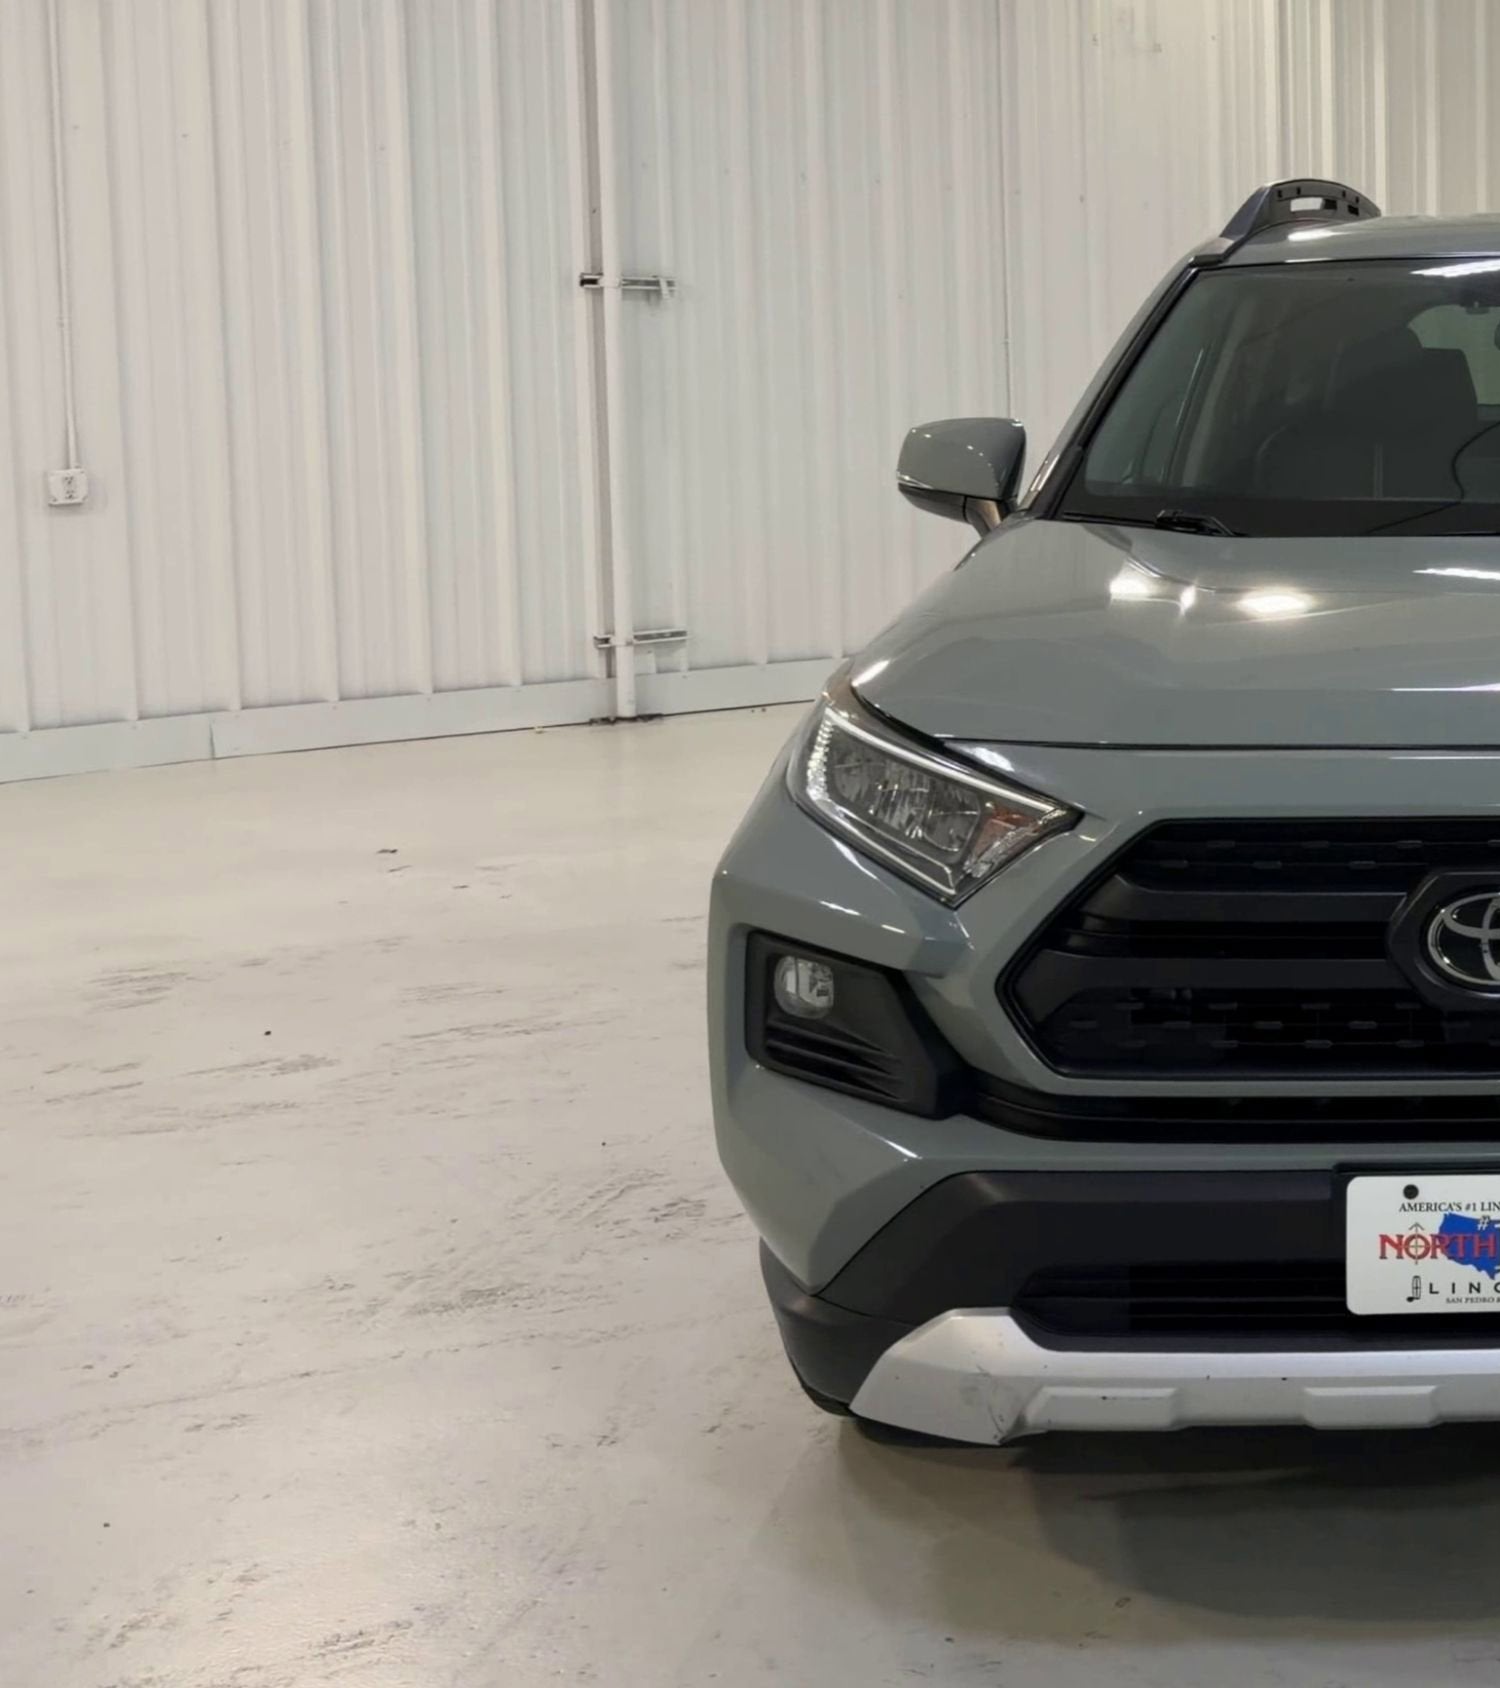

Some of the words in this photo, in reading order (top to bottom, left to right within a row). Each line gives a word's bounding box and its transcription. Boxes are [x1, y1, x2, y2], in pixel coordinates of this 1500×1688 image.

[1399, 1202, 1462, 1212] AMERICA'S
[1465, 1202, 1477, 1212] #1
[1379, 1233, 1497, 1260] NORTH
[1446, 1296, 1463, 1304] SAN
[1464, 1296, 1495, 1304] PEDRO
